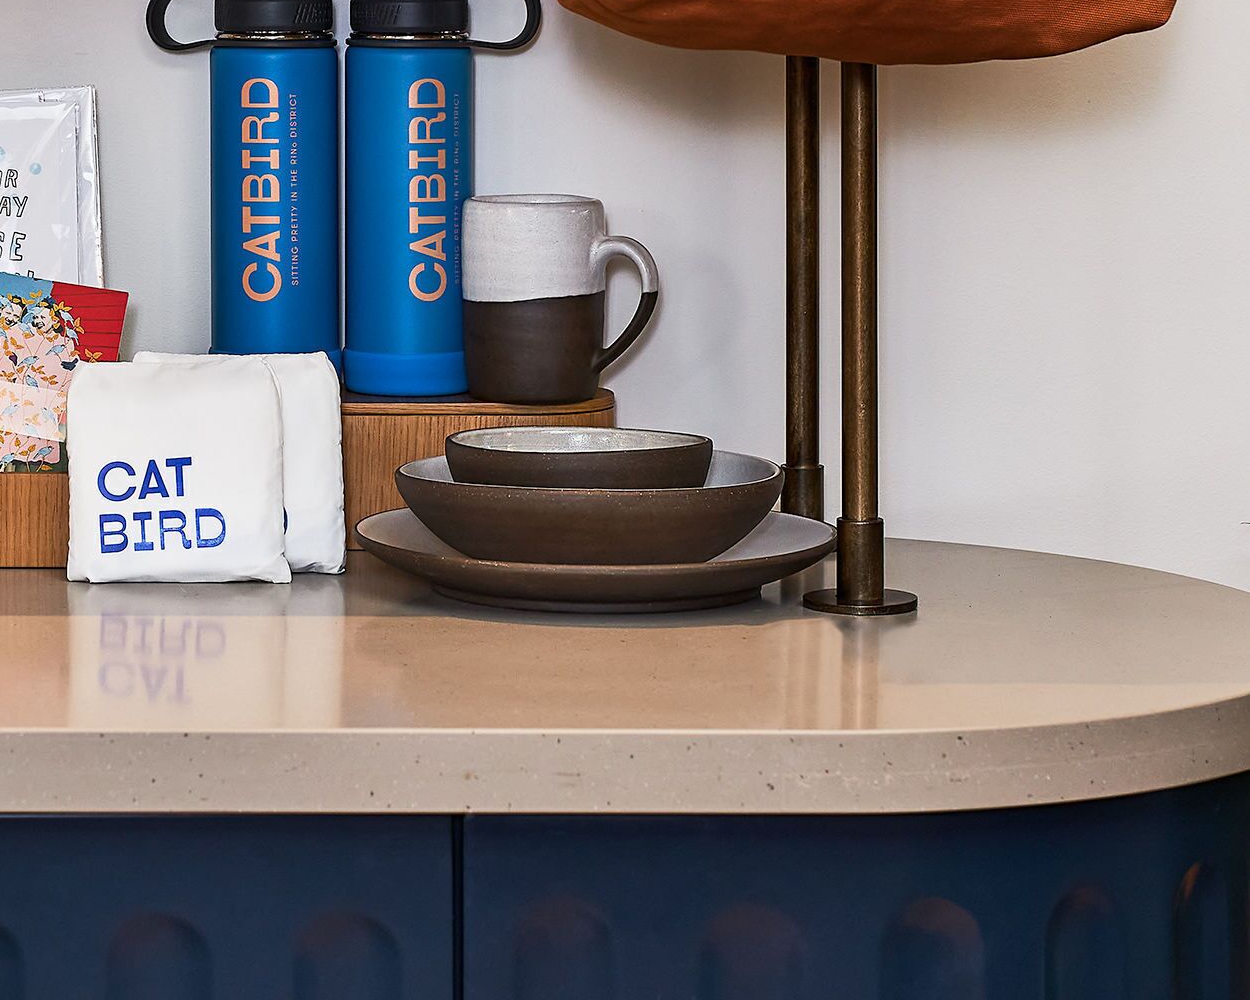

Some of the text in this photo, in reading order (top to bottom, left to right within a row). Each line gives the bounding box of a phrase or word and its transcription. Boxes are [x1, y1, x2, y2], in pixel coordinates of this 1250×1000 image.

[289, 94, 297, 138] DISTRICT
[241, 77, 282, 303] CATBIRD
[290, 169, 298, 188] THE
[291, 191, 298, 202] IN
[408, 77, 448, 303] CATBIRD
[291, 246, 299, 286] SITTING
[97, 456, 192, 502] CAT
[99, 507, 227, 554] BIRD
